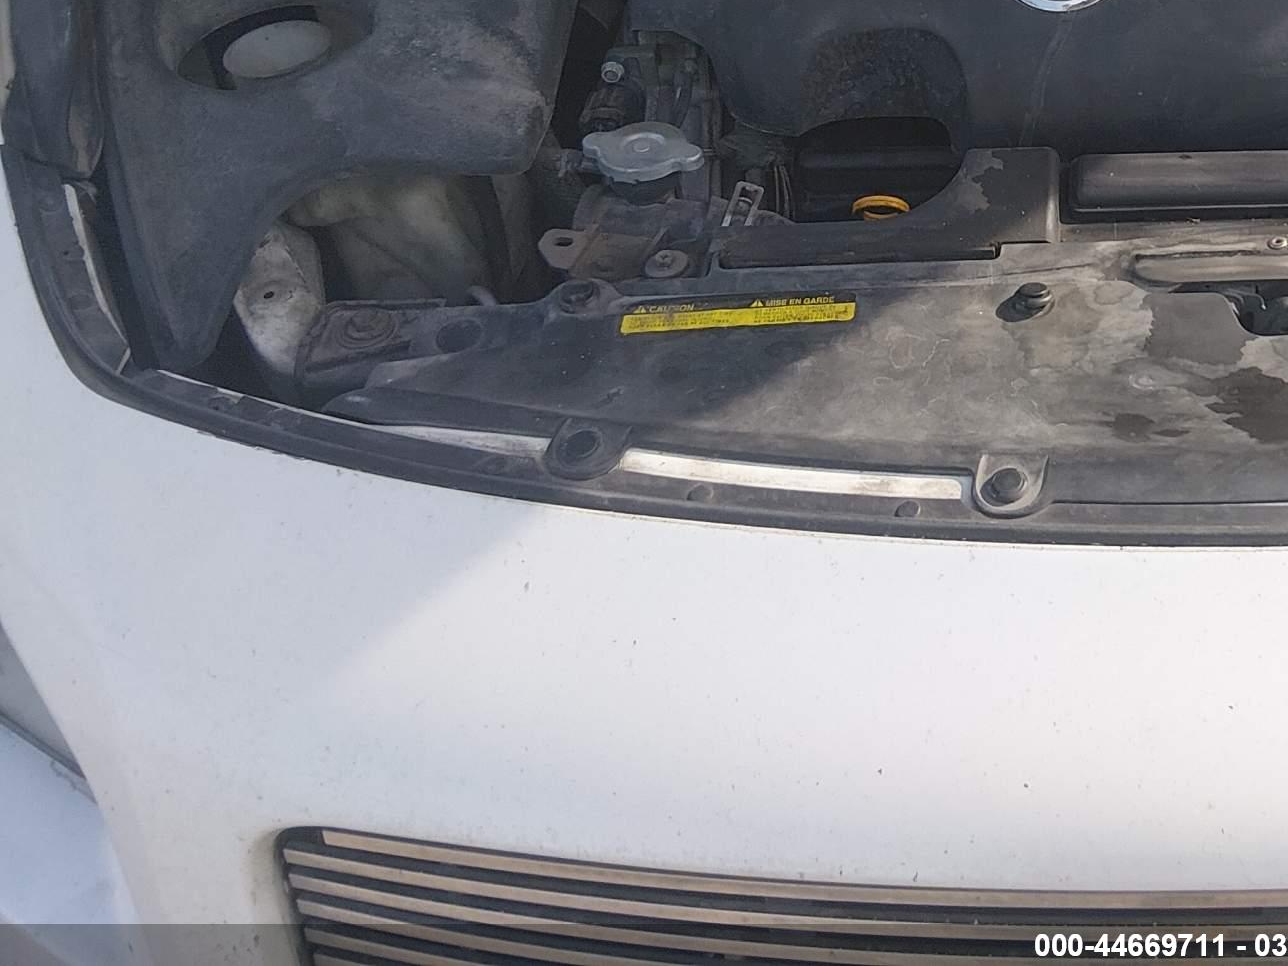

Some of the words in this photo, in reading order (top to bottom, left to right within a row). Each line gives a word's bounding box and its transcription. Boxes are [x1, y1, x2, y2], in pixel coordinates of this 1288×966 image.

[765, 298, 787, 307] MISE
[789, 297, 802, 305] EN
[803, 296, 835, 305] GARDE
[648, 303, 695, 314] CAUON
